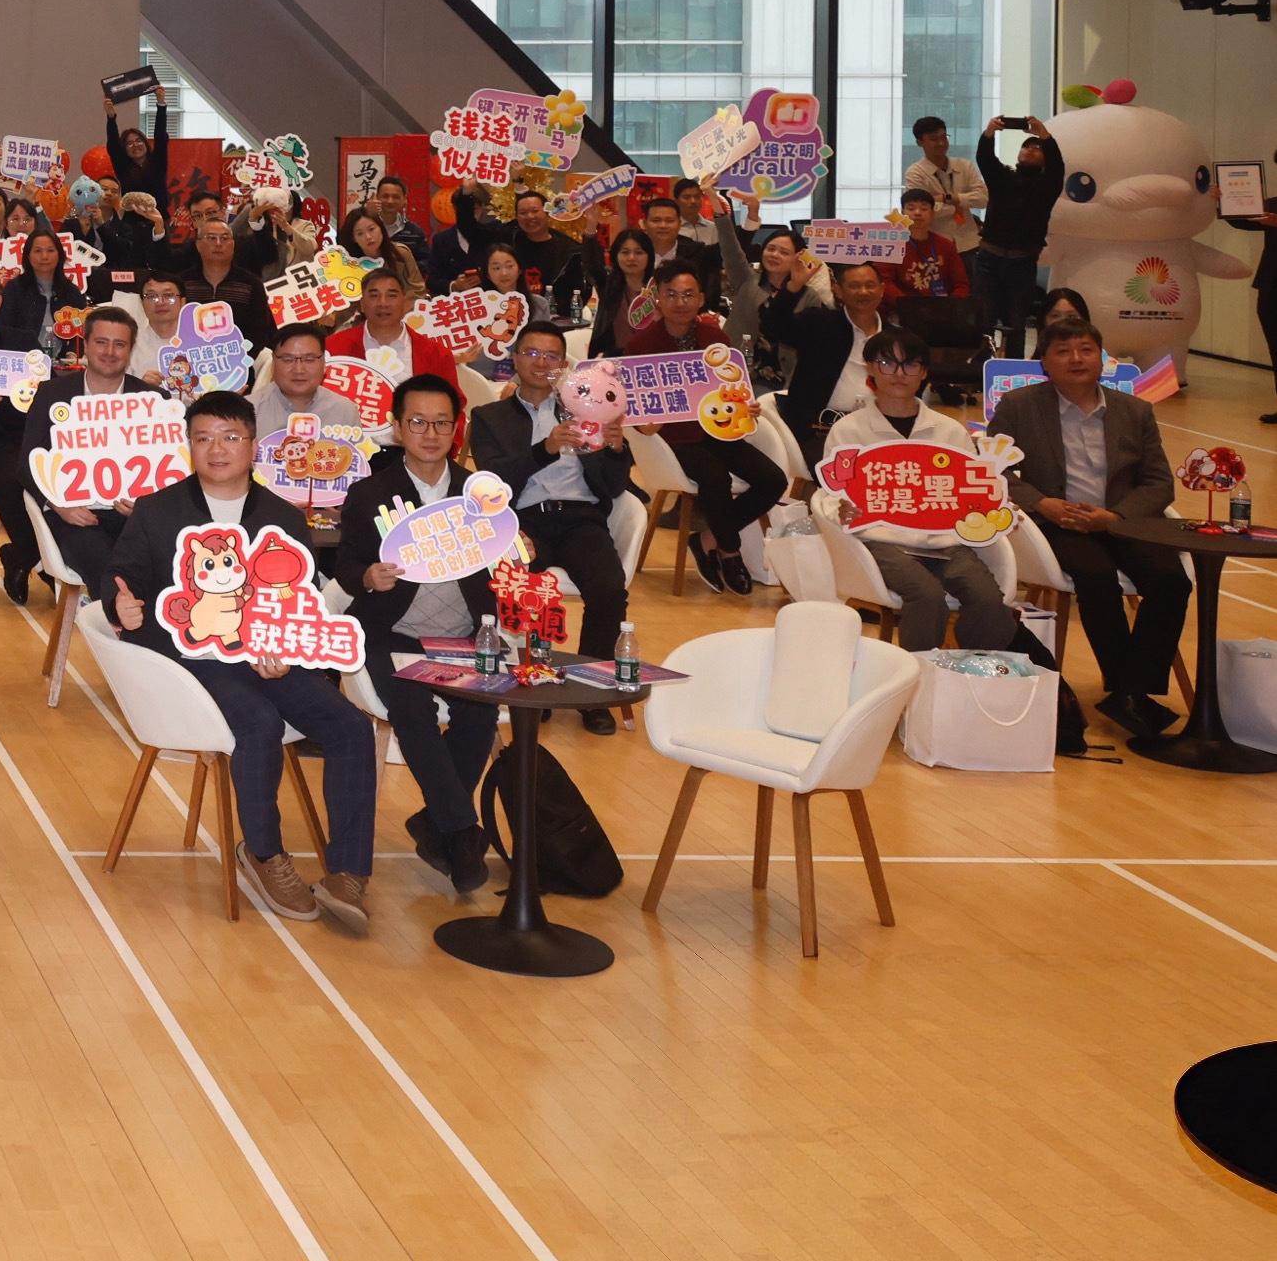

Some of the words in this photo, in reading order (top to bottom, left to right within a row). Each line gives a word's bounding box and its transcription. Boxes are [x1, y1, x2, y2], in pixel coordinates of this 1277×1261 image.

[448, 110, 513, 147] 钱途
[7, 141, 52, 158] 马到成功
[246, 154, 275, 172] 马上
[442, 147, 507, 184] 似锦
[265, 265, 319, 292] 一马
[288, 285, 347, 322] 当先
[429, 291, 487, 328] 幸福
[323, 364, 384, 400] 马住
[77, 397, 156, 422] HAPPY
[56, 426, 108, 450] NEW
[123, 422, 184, 446] YEAR
[60, 454, 190, 502] 2026
[861, 460, 922, 487] 你我
[865, 488, 918, 515] 皆是
[410, 504, 467, 541] 植根于
[399, 517, 496, 566] 开放与务实
[426, 547, 487, 580] 的创新
[251, 587, 318, 622] 马上
[248, 621, 353, 659] 就转运
